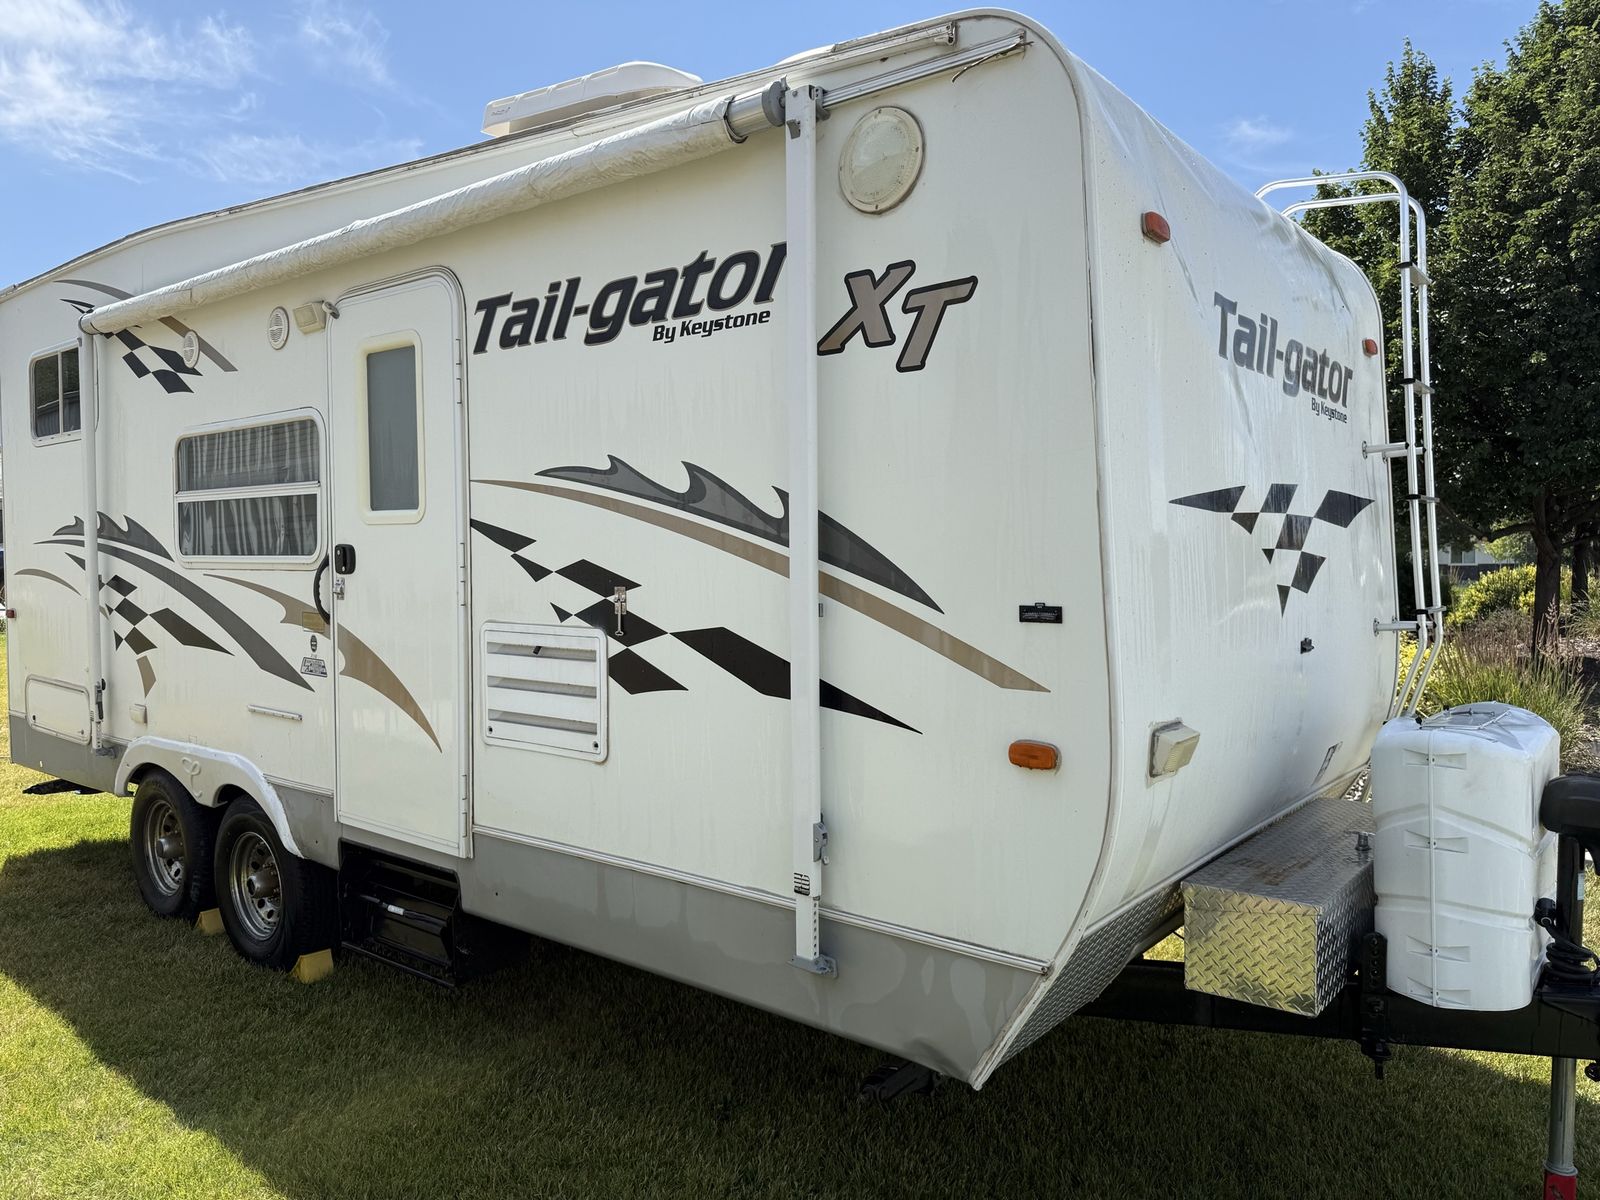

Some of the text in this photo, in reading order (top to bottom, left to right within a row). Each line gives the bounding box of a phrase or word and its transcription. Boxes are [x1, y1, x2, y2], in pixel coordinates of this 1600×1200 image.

[653, 310, 771, 344] By Keystone
[817, 259, 979, 373] XT
[1213, 290, 1353, 408] Tail-gator
[1311, 397, 1347, 424] By Keystone
